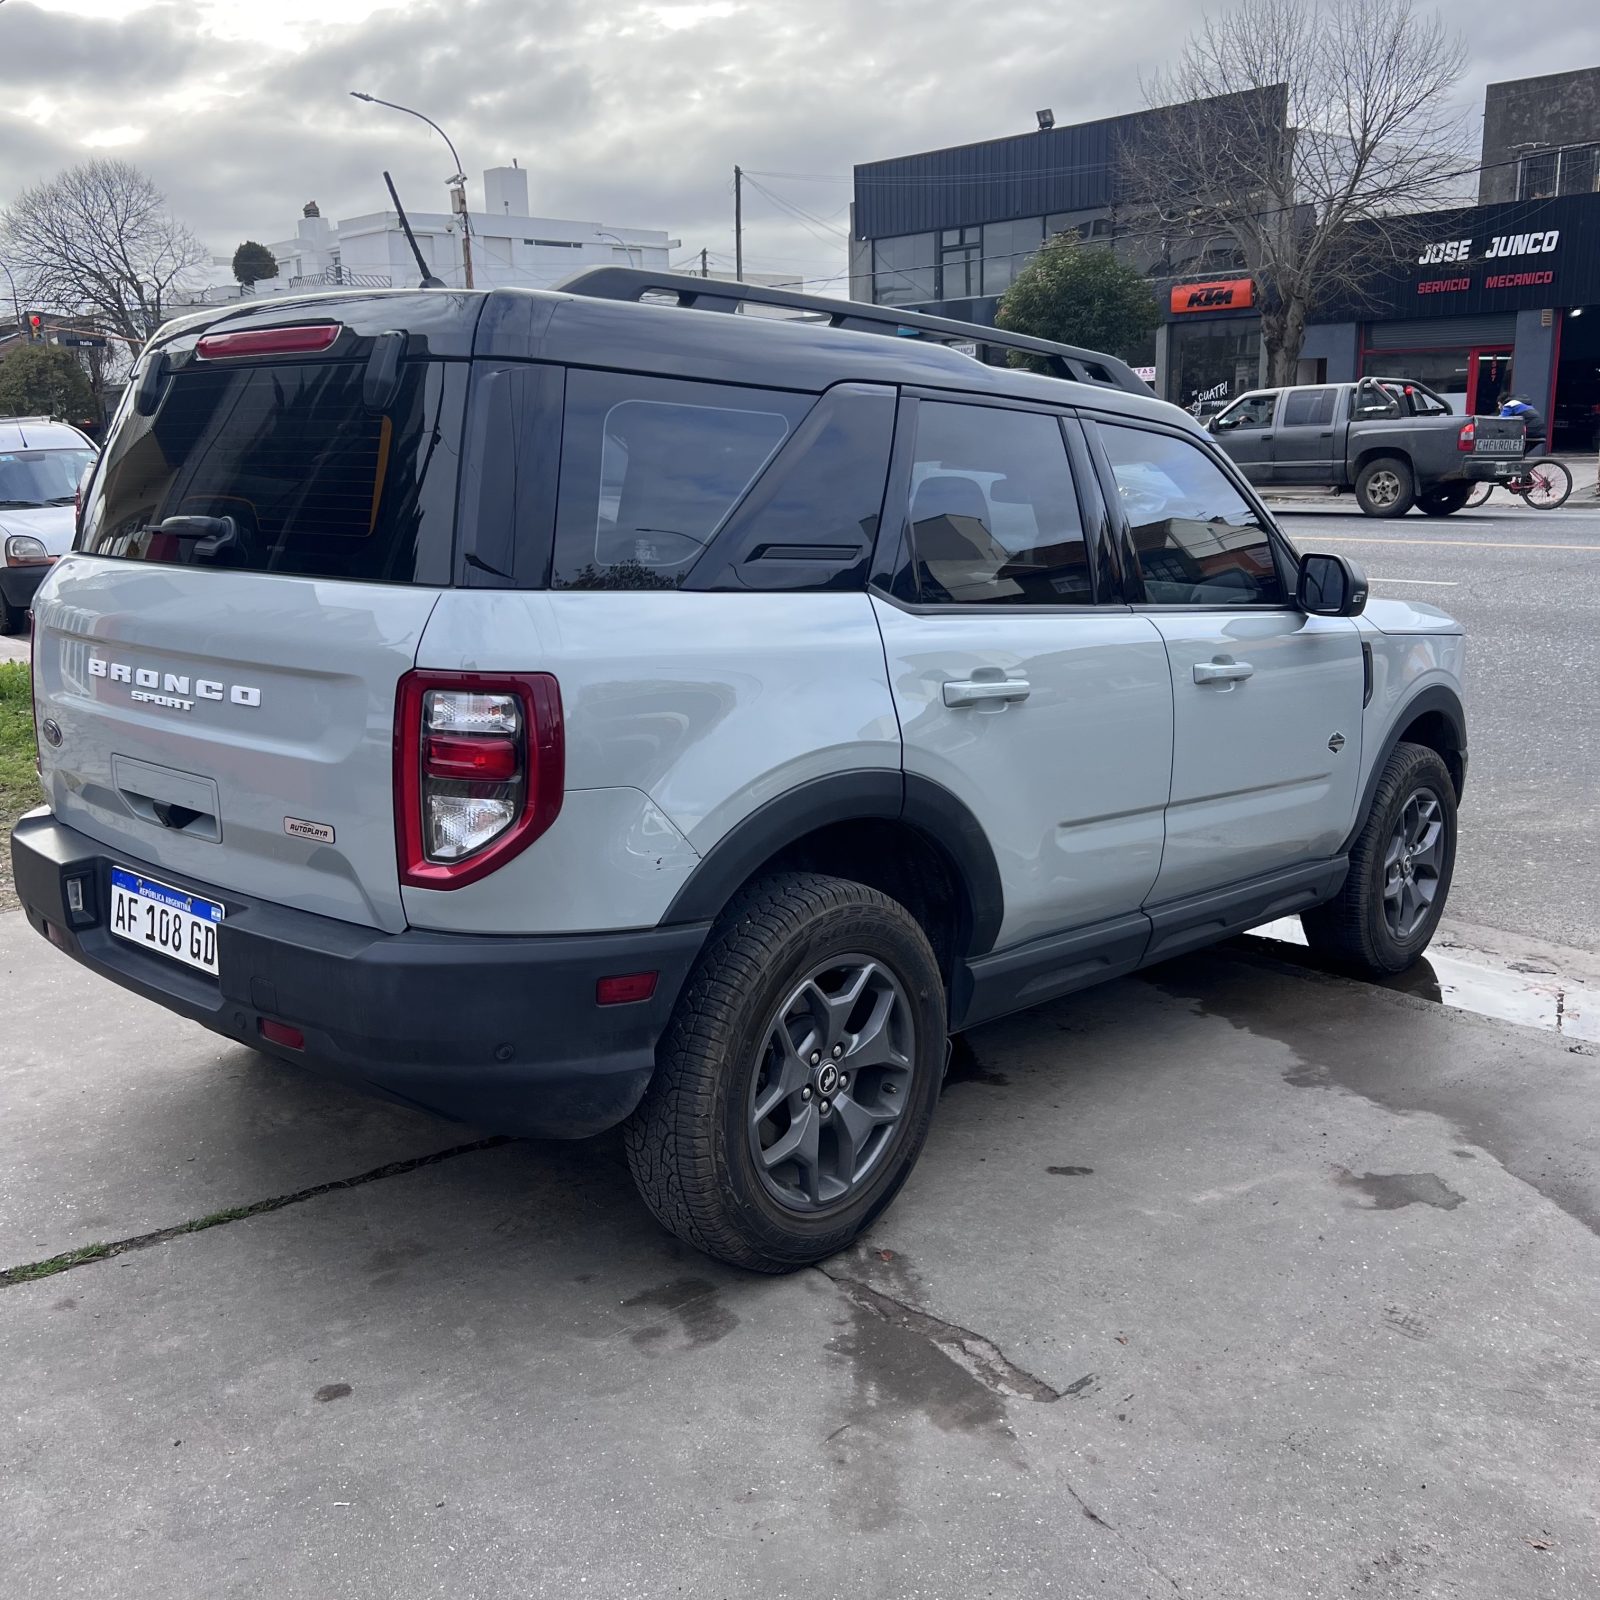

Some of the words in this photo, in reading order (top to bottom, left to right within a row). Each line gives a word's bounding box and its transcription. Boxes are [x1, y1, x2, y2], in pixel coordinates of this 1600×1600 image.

[1418, 239, 1472, 265] JOSE
[1485, 230, 1560, 259] JUNCO
[1417, 278, 1471, 294] SERVICIO
[1485, 271, 1553, 289] MECANICO
[1187, 287, 1234, 308] KTM
[1198, 381, 1228, 401] CUATRI
[1477, 439, 1522, 451] CHEVROLET
[88, 658, 261, 707] BRONCO
[131, 690, 195, 711] SPORT
[290, 823, 328, 838] AUTOPLAYA
[139, 887, 165, 903] REPÚBLICA
[165, 896, 192, 912] ARGENTINA
[115, 893, 139, 933] AF
[145, 904, 182, 952] 108
[190, 921, 216, 966] GD
